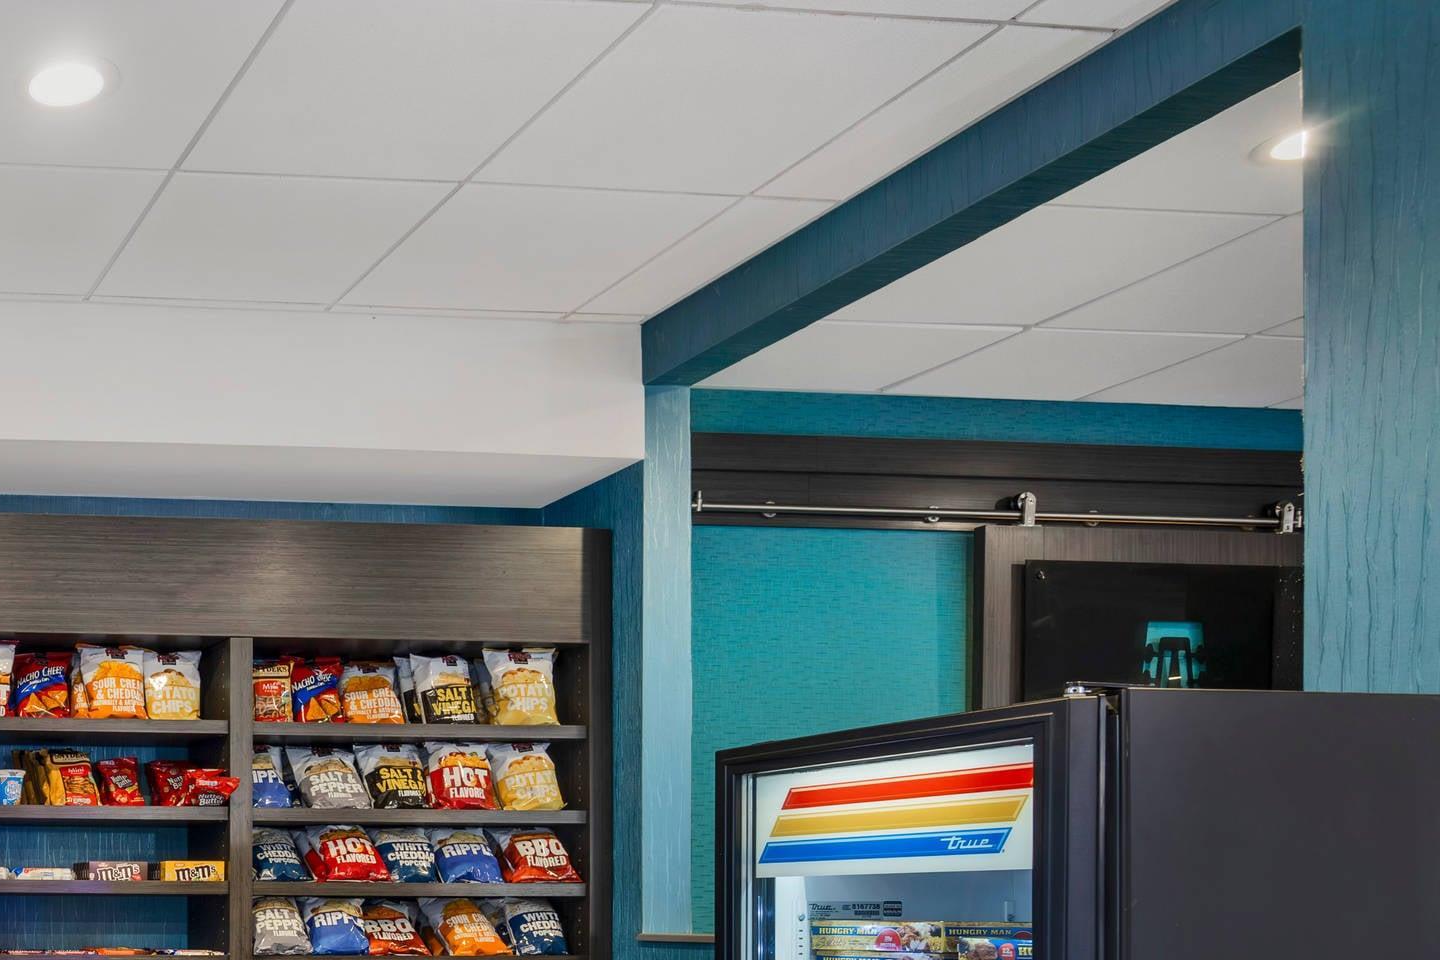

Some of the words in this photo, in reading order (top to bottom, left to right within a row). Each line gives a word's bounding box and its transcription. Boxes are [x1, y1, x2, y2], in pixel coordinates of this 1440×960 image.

[93, 677, 116, 690] SOUR
[291, 675, 315, 692] NACHO
[345, 690, 368, 702] SOUR
[437, 687, 467, 701] SALT
[152, 700, 193, 714] CHIPS
[432, 700, 477, 716] VINEGA
[507, 698, 548, 711] CHIPS
[310, 772, 343, 785] SALT
[347, 774, 356, 783] &
[379, 767, 413, 779] SALT
[443, 767, 488, 788] HOT
[311, 782, 364, 796] PEPPER
[326, 836, 375, 858] HOT
[392, 842, 430, 852] WHITE
[514, 838, 569, 857] BBQ
[940, 835, 994, 850] true
[336, 853, 377, 865] FLAVORED
[526, 855, 567, 868] FLAVORED
[255, 908, 289, 921] SALT
[364, 918, 415, 933] BBQ
